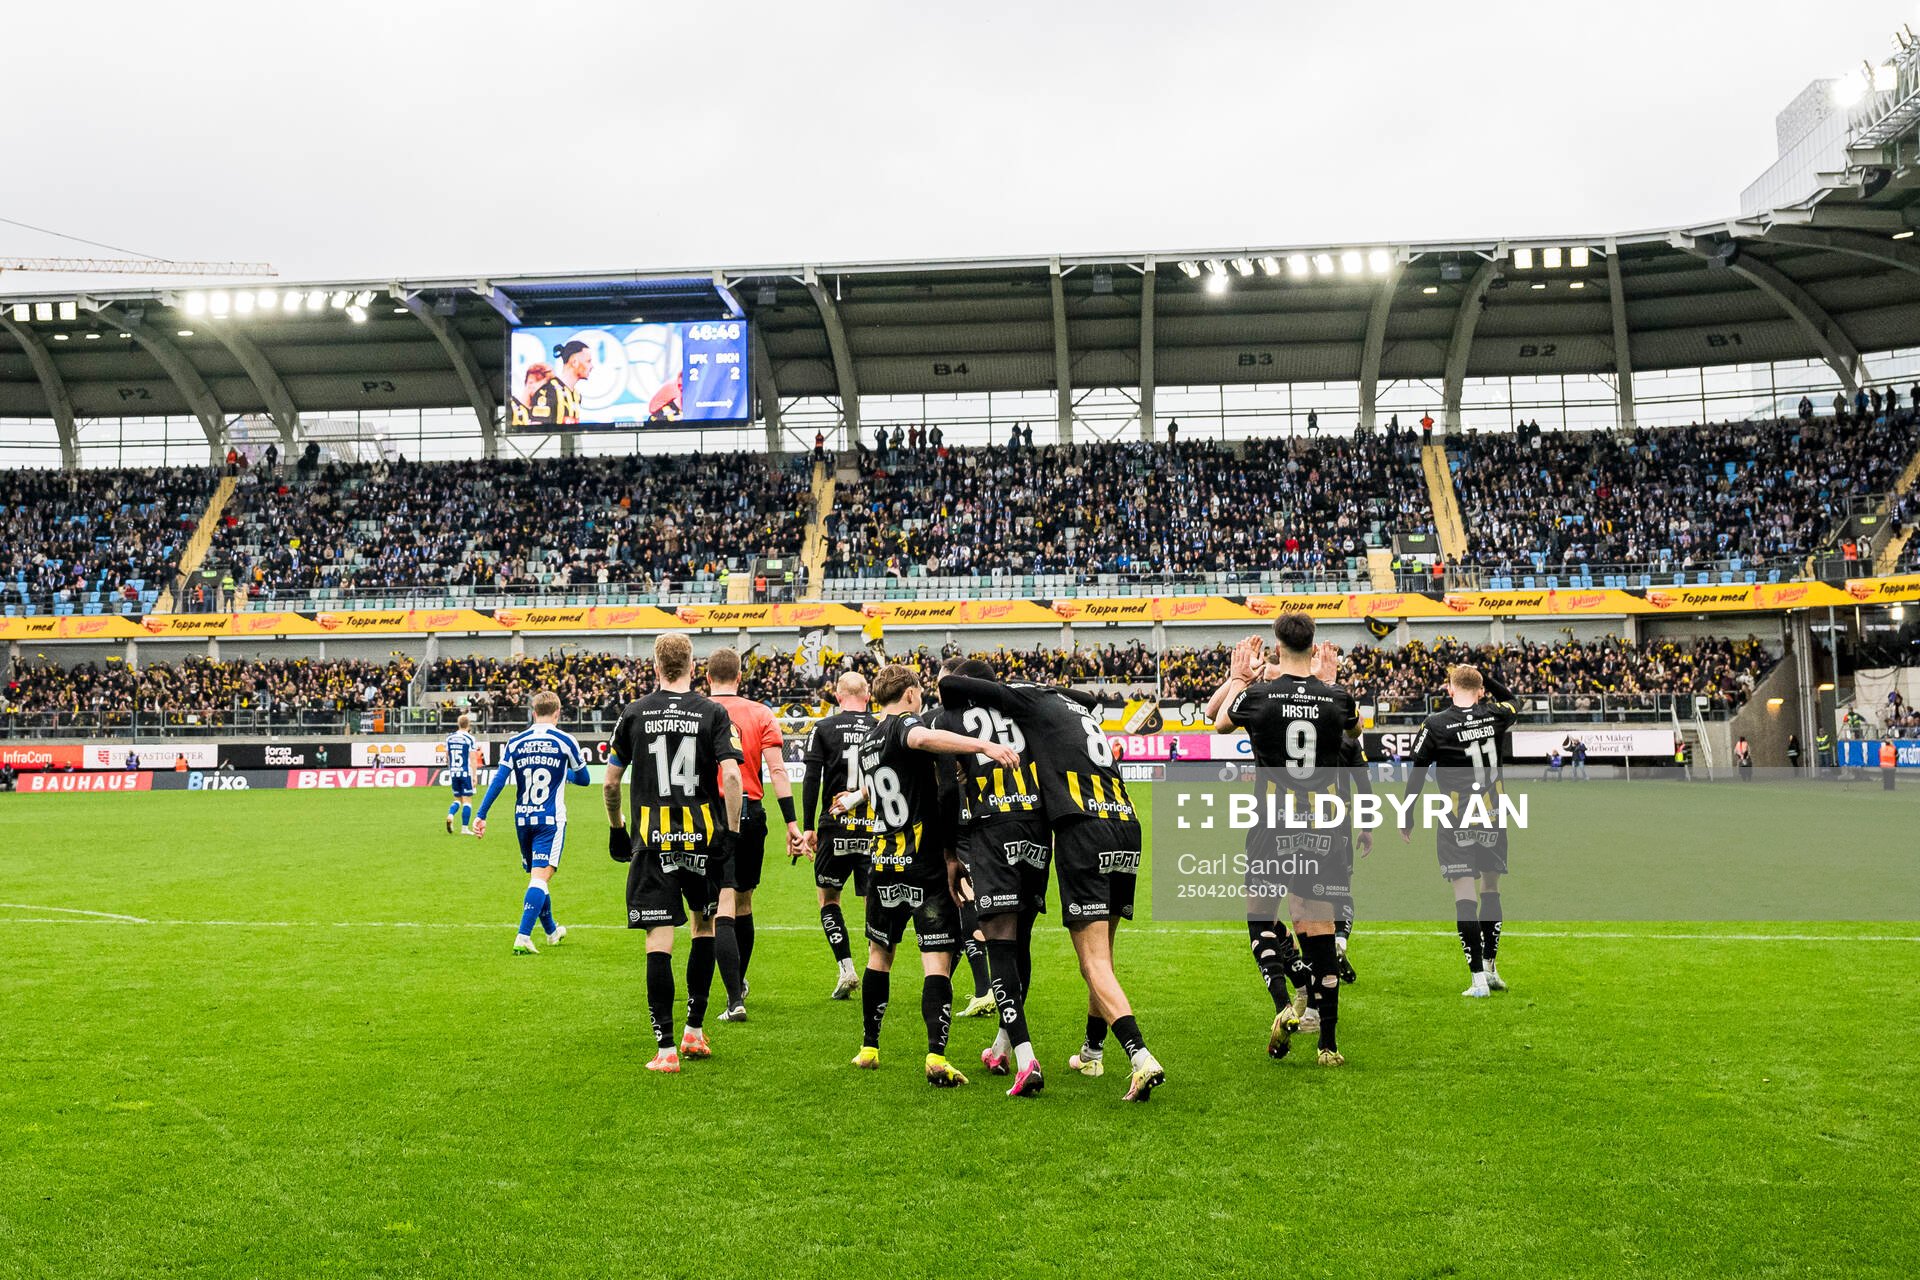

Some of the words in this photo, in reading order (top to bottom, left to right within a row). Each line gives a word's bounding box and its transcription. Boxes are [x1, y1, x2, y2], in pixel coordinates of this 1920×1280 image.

[1706, 334, 1742, 347] B1
[1519, 345, 1557, 357] B2
[1238, 353, 1272, 366] B3
[690, 368, 699, 381] 2
[731, 366, 740, 380] 2
[933, 363, 969, 375] B4
[361, 381, 396, 393] P3
[119, 388, 152, 400] P2
[1880, 583, 1905, 595] Toppa
[1478, 597, 1512, 608] Toppa
[1515, 596, 1543, 606] med
[1682, 593, 1716, 604] Toppa
[1719, 591, 1747, 601] med
[894, 607, 927, 618] Toppa
[929, 606, 955, 616] med
[1085, 604, 1118, 615] Toppa
[1120, 602, 1147, 613] med
[1280, 600, 1314, 612] Toppa
[1316, 600, 1344, 610] med
[346, 616, 377, 627] Toppa
[379, 615, 403, 625] med
[526, 613, 556, 623] Toppa
[558, 612, 583, 622] med
[707, 611, 739, 621] Toppa
[742, 609, 767, 619] med
[171, 619, 201, 630] Toppa
[203, 619, 227, 629] med
[1317, 695, 1334, 703] PARK
[1282, 704, 1319, 719] HRSTIĆ
[645, 719, 699, 734] GUSTAFSON
[963, 707, 1026, 766] 25
[1081, 715, 1114, 768] 8
[265, 745, 291, 755] forza
[518, 745, 559, 754] WELLNESS
[1286, 720, 1317, 779] 9
[3, 750, 52, 764] InfraCom
[265, 755, 304, 765] football
[451, 750, 464, 767] 15
[516, 755, 561, 769] ERIKSSON
[1464, 738, 1498, 787] 11
[648, 735, 700, 797] 14
[1122, 765, 1153, 779] weber
[32, 774, 138, 790] BAUHAUS
[188, 771, 249, 790] Brixo.
[298, 769, 417, 788] BEVEGO
[522, 768, 552, 805] 18
[989, 792, 1038, 806] Hybridge
[1088, 799, 1132, 815] Hybridge
[652, 830, 703, 843] Hybridge
[871, 852, 912, 866] Hybridge
[877, 883, 923, 908] DEMO
